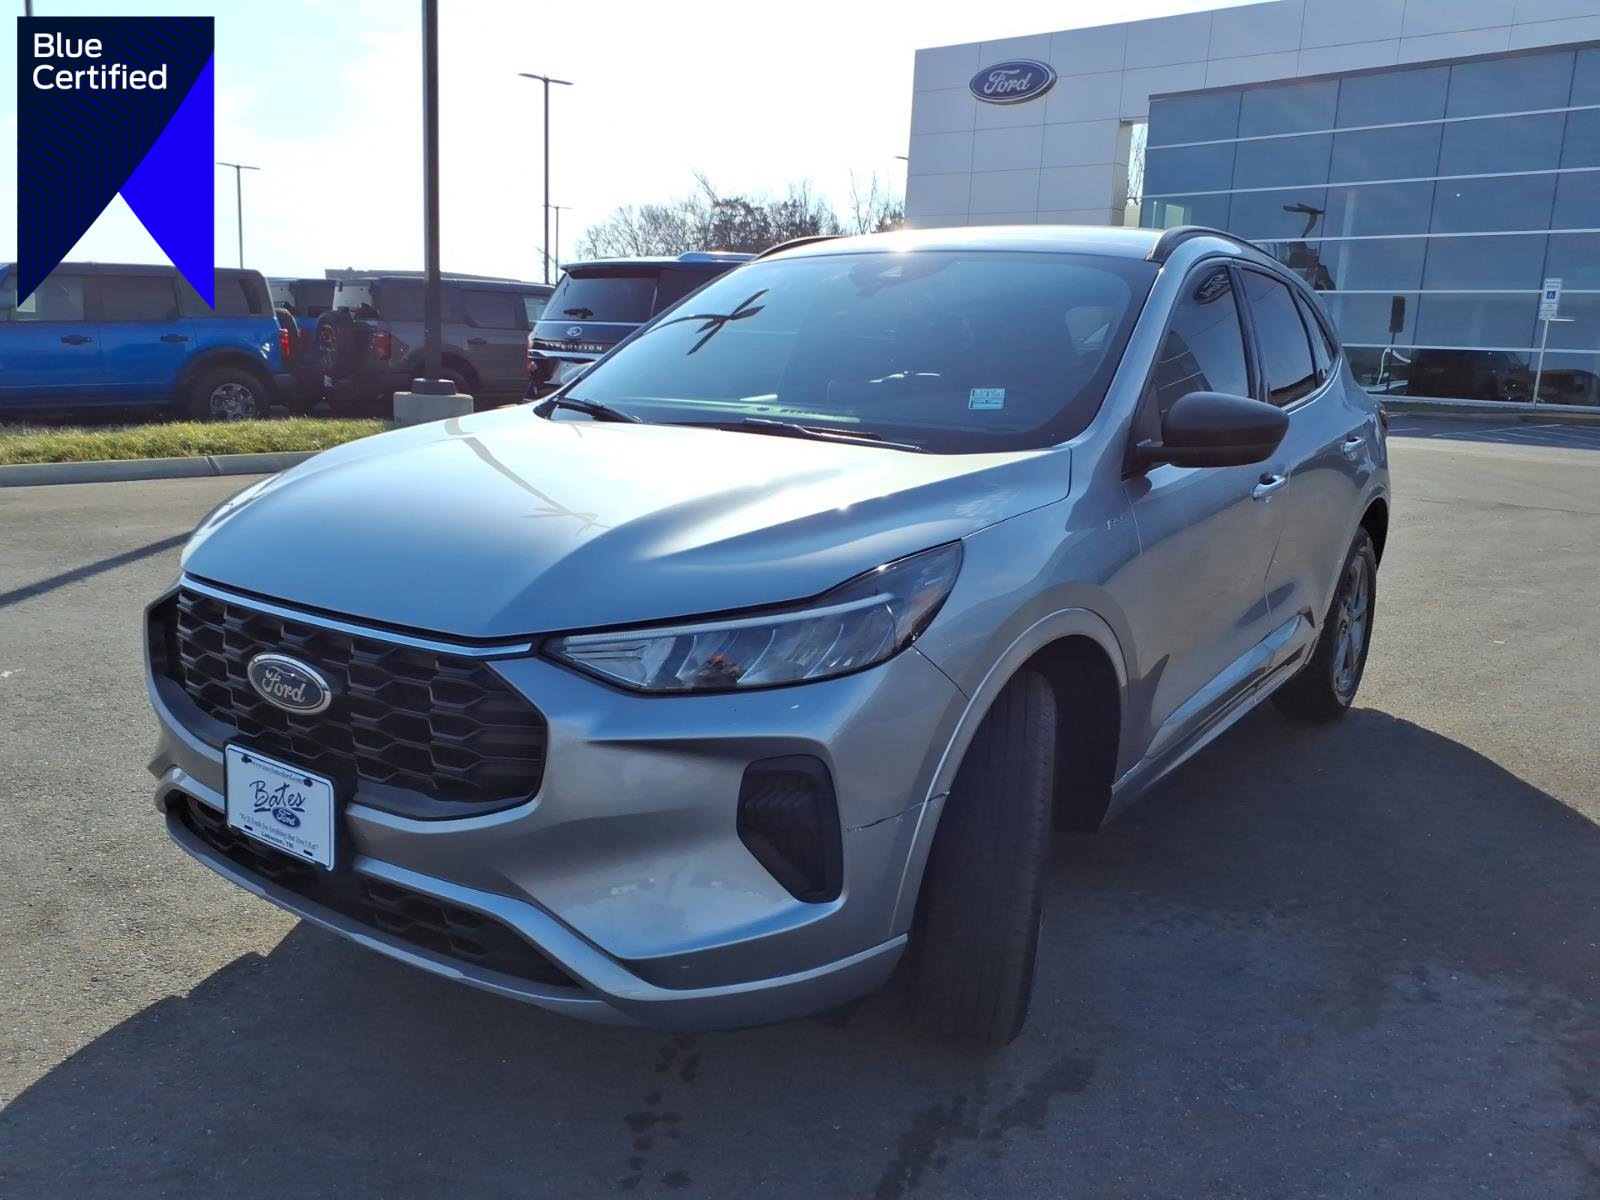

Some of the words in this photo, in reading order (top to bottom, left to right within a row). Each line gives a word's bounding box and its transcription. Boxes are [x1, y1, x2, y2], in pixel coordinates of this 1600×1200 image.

[984, 68, 1032, 94] Ford
[262, 666, 307, 703] Ford
[249, 780, 306, 808] Bates
[276, 808, 297, 826] Ford
